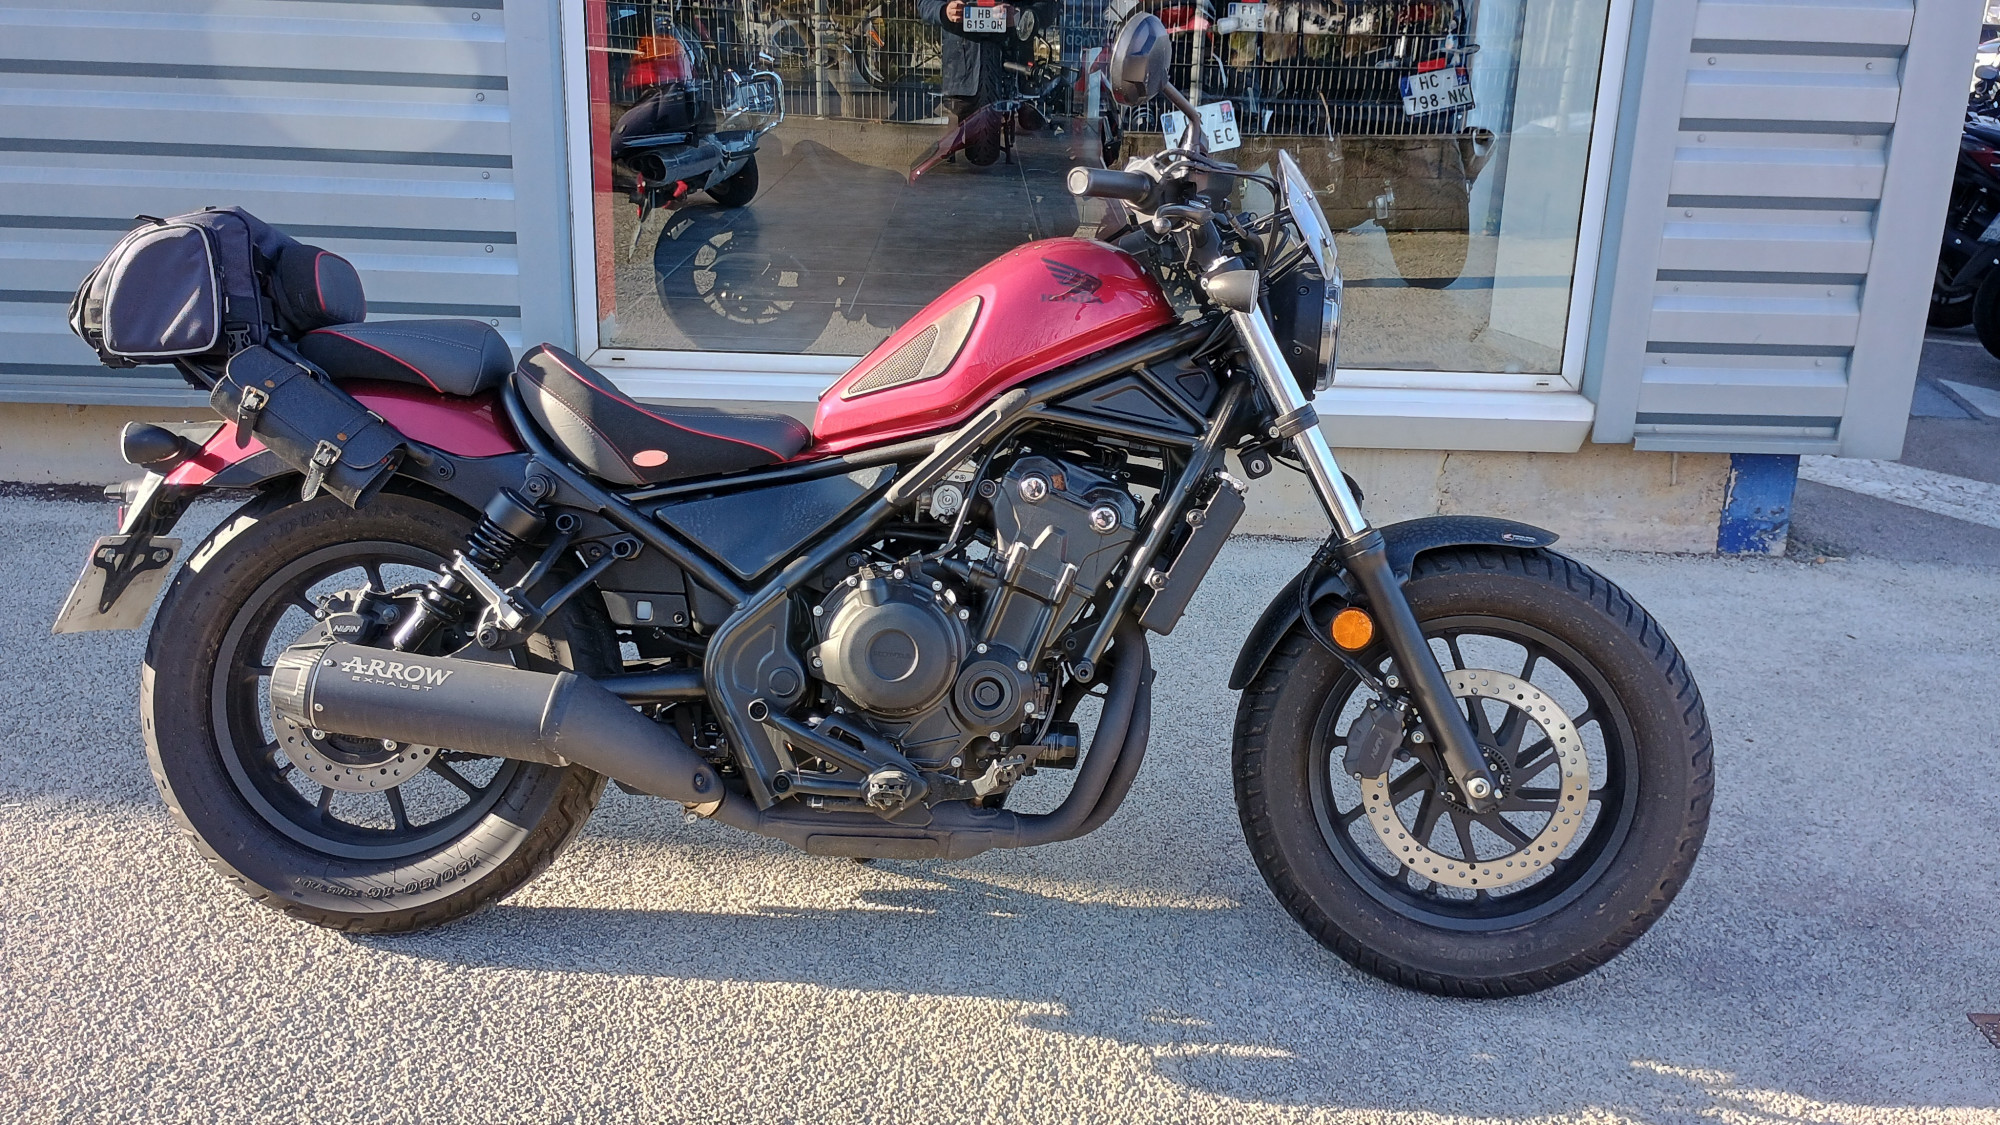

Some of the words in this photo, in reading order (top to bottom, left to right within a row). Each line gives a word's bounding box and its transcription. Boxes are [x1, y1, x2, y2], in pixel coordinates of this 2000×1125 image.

[977, 9, 991, 19] HB
[1408, 87, 1468, 112] 798-NK
[340, 656, 454, 686] ARROW
[351, 675, 433, 692] EXHAUST
